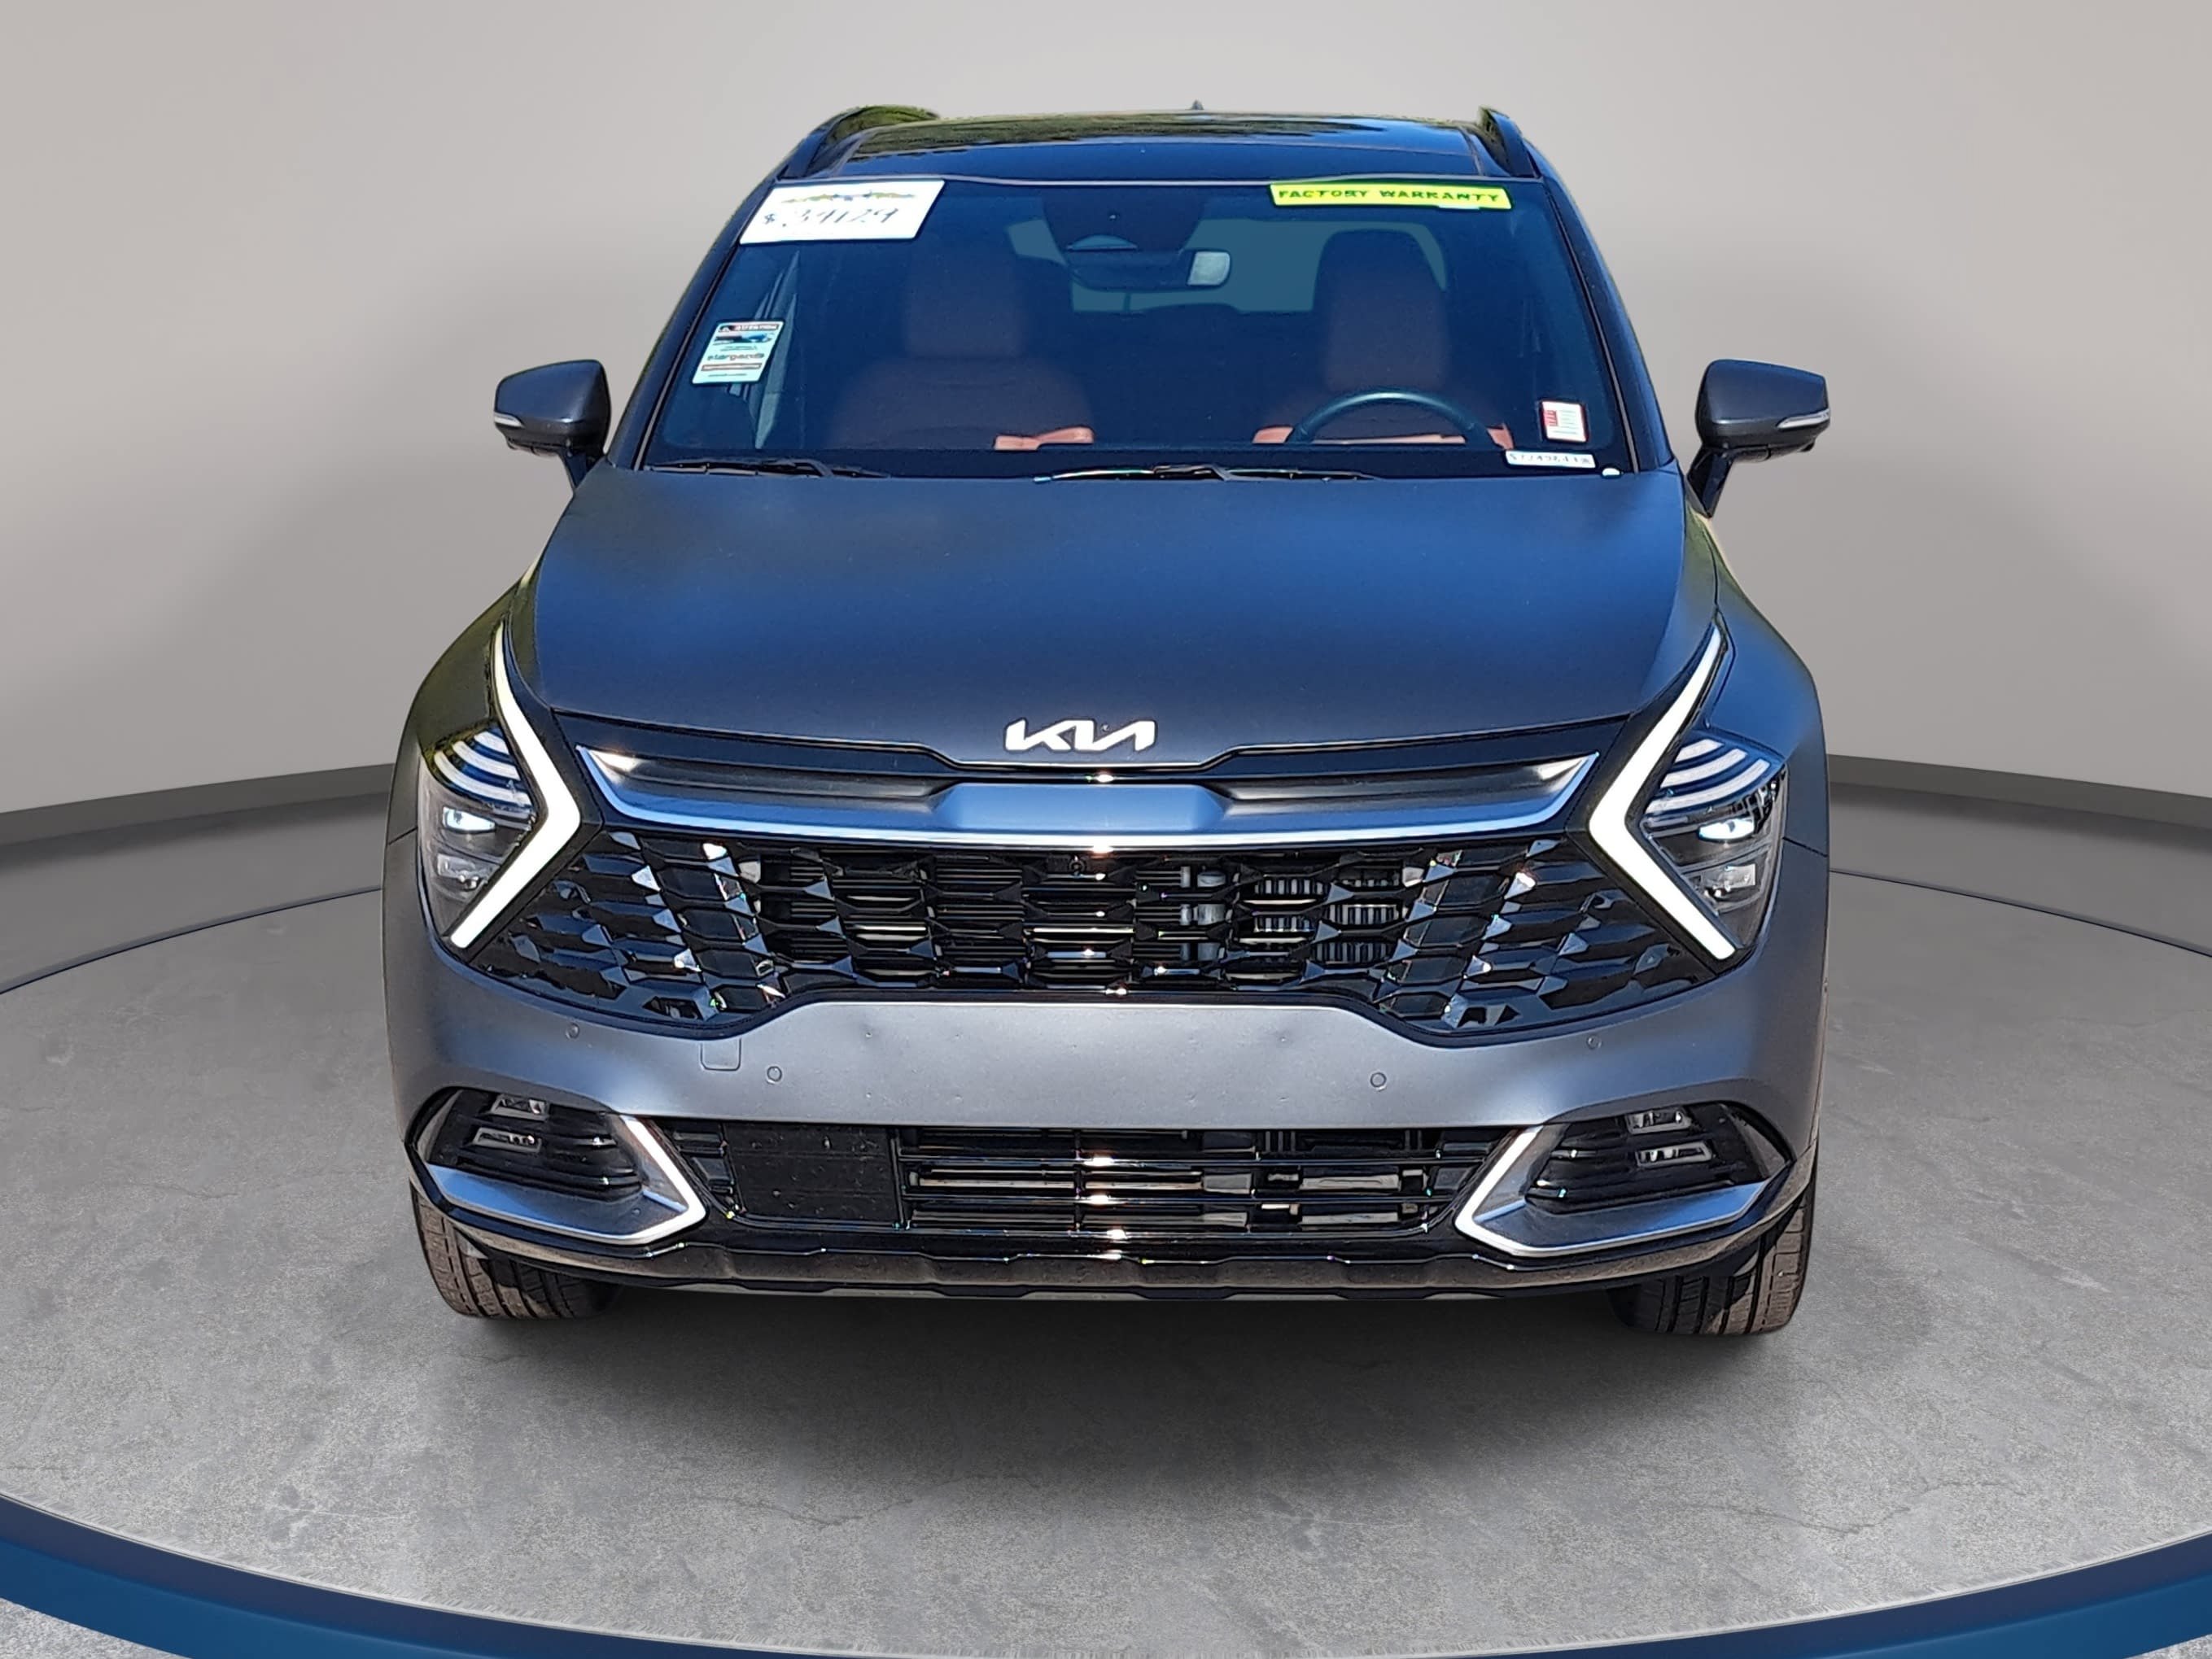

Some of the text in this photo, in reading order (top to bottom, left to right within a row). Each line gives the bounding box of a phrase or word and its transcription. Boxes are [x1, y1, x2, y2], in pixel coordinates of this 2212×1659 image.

[1278, 190, 1500, 202] FACTORY WARRANTY
[1004, 718, 1156, 752] KIA
